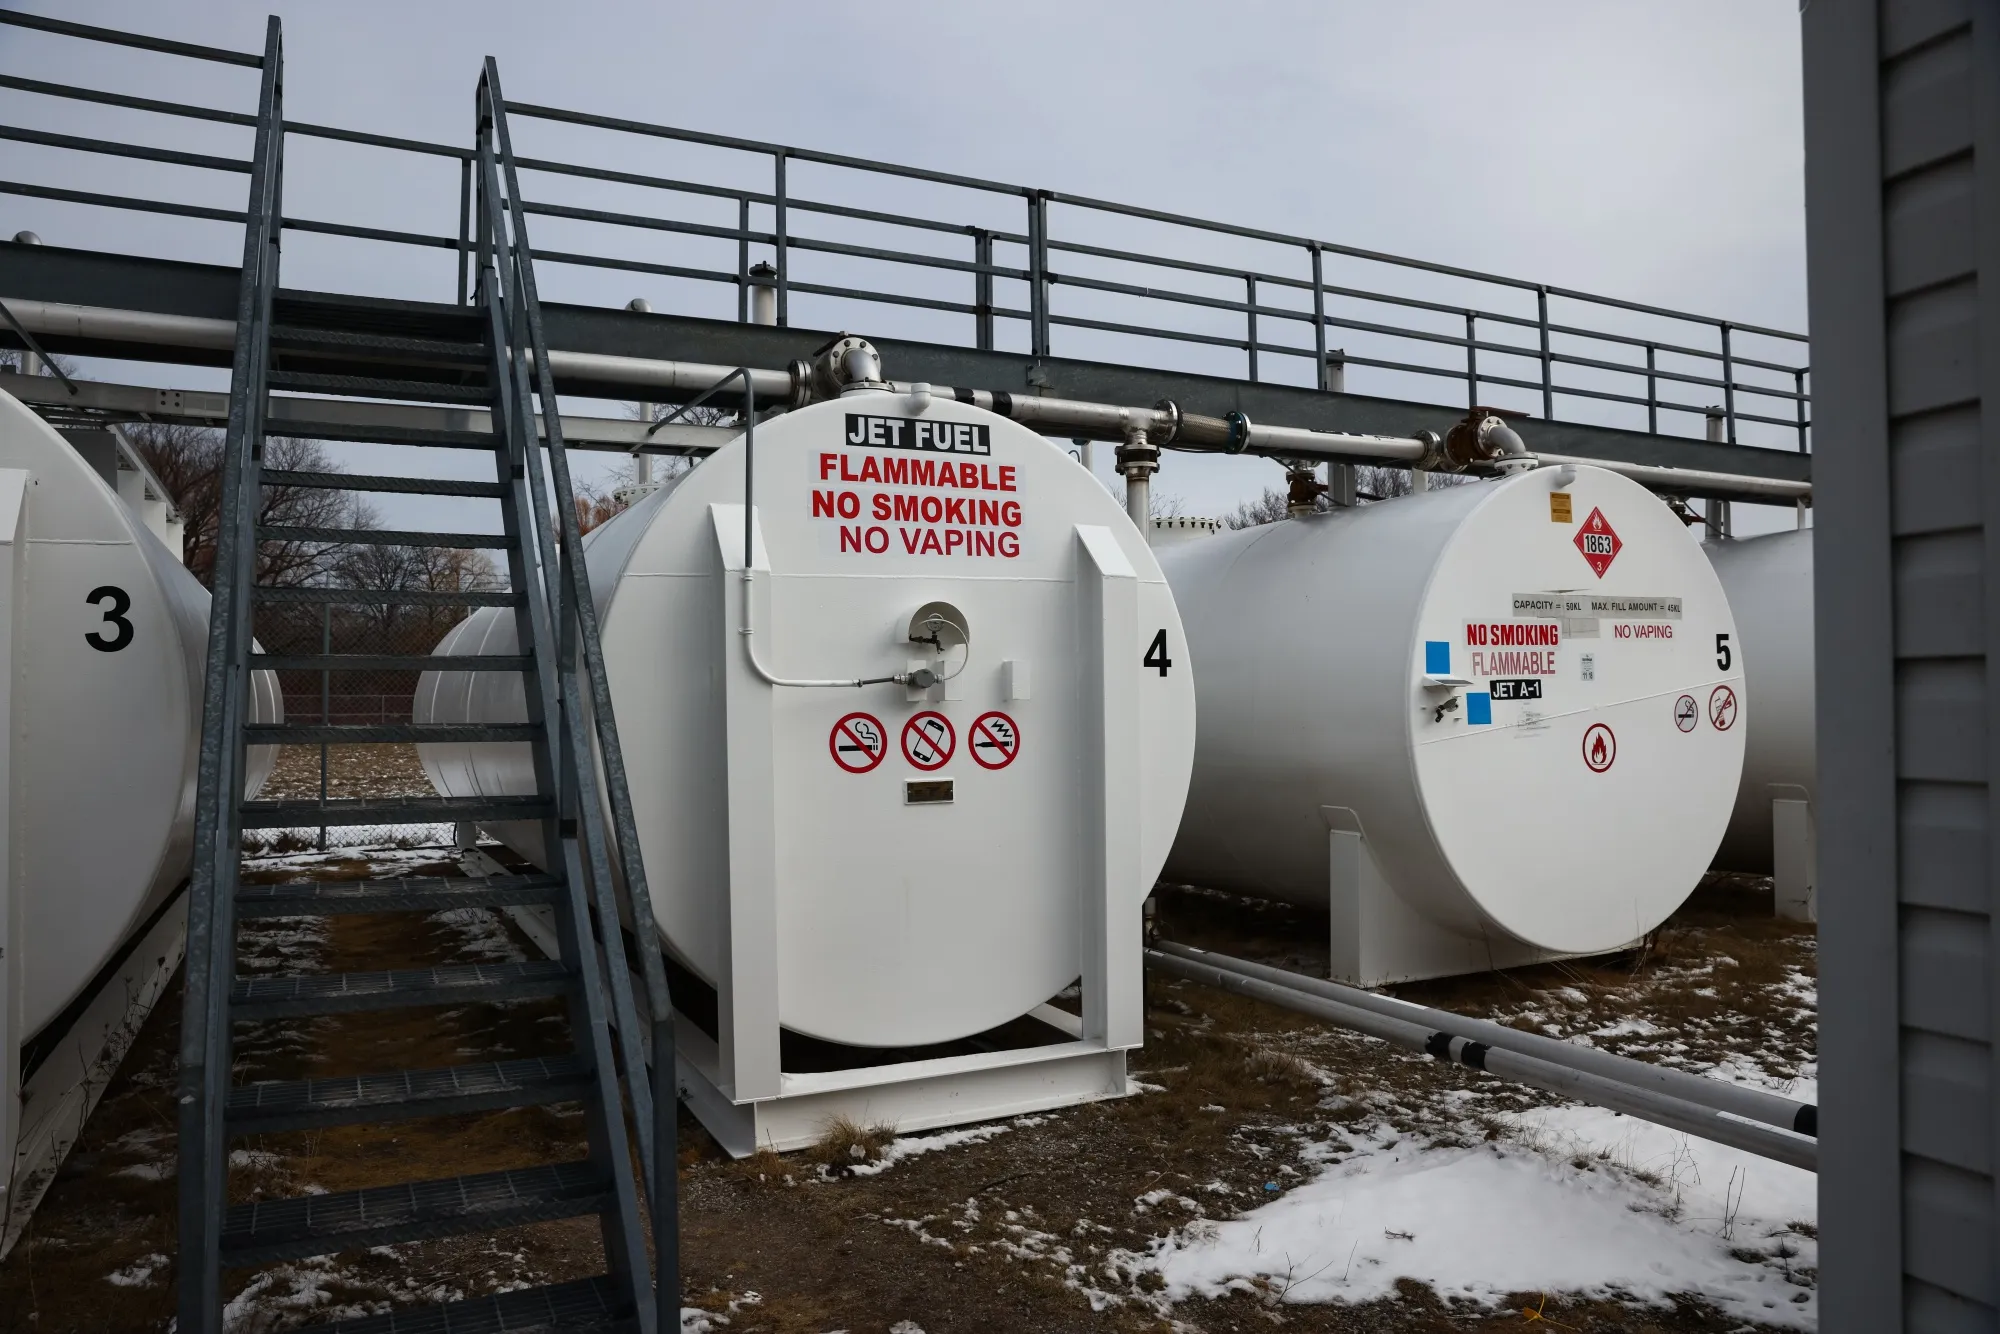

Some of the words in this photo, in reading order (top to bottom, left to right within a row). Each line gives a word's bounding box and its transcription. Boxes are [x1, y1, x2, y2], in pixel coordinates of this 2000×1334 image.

[849, 417, 904, 446] JET
[915, 421, 988, 453] FUEL
[820, 453, 1017, 492] FLAMMABLE
[812, 490, 861, 519] NO
[872, 493, 1022, 528] SMOKING
[840, 526, 889, 554] NO
[899, 528, 1020, 558] VAPING
[1585, 535, 1611, 554] 1863
[1597, 561, 1602, 572] 3
[85, 585, 134, 652] 3
[1513, 600, 1553, 610] CAPACITY
[1565, 602, 1582, 611] 50KL
[1591, 602, 1609, 611] MAX.
[1611, 602, 1627, 611] FILL
[1628, 602, 1658, 612] AMOUNT
[1667, 604, 1681, 613] 45KL
[1466, 623, 1487, 646] NO
[1490, 624, 1559, 646] SMOKING
[1614, 624, 1631, 639] NO
[1633, 624, 1673, 639] VAPING
[1143, 628, 1172, 678] 4
[1472, 651, 1556, 676] FLAMMABLE
[1716, 633, 1732, 672] 5
[1492, 682, 1515, 698] JET
[1519, 681, 1540, 698] A-1
